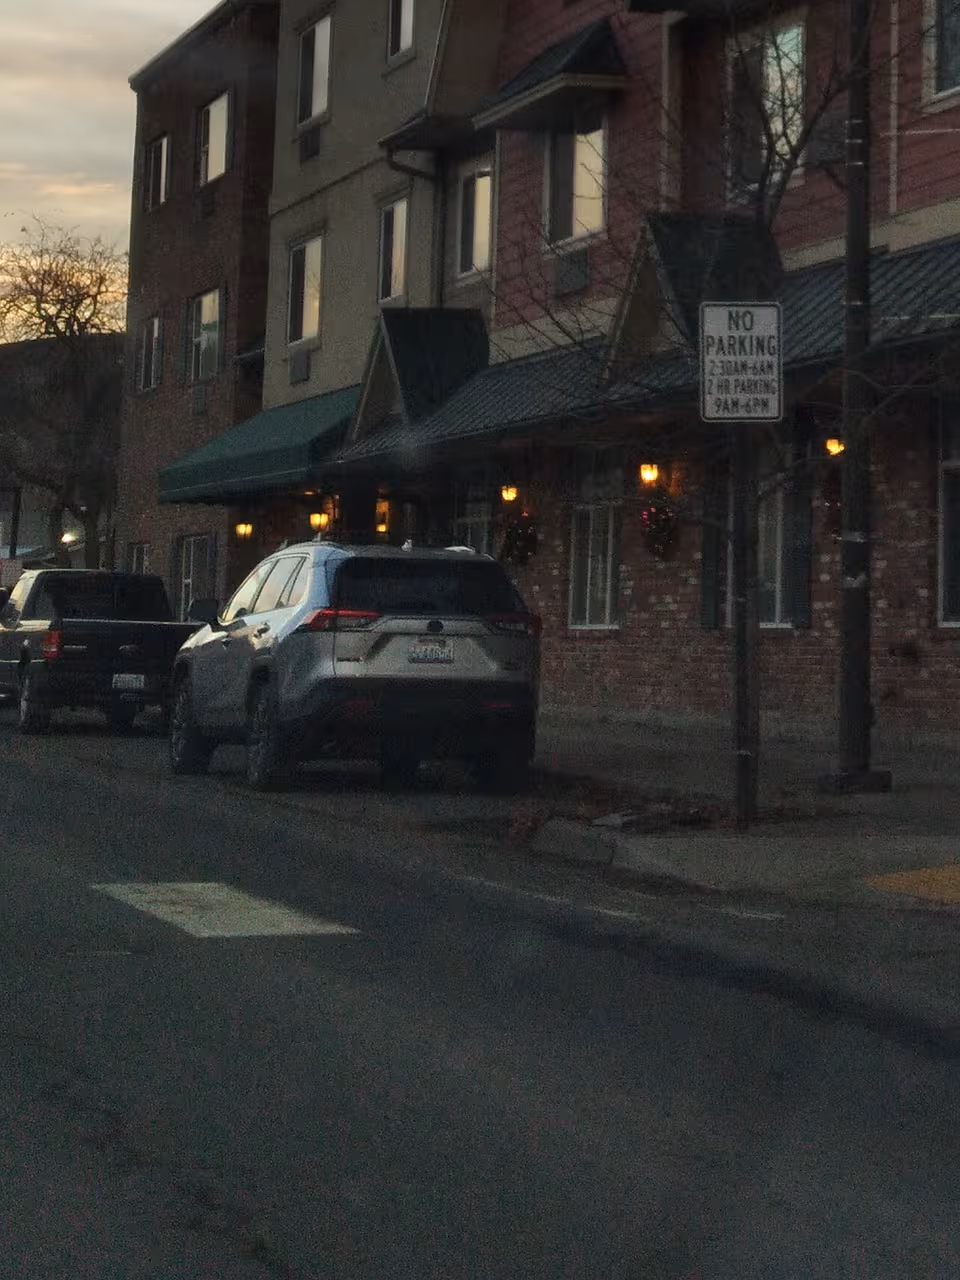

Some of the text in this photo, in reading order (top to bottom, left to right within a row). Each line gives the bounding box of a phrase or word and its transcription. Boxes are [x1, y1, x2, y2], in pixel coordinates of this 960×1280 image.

[728, 310, 754, 331] NO
[705, 335, 776, 356] PARKING
[707, 379, 777, 395] 2 HR PARKING
